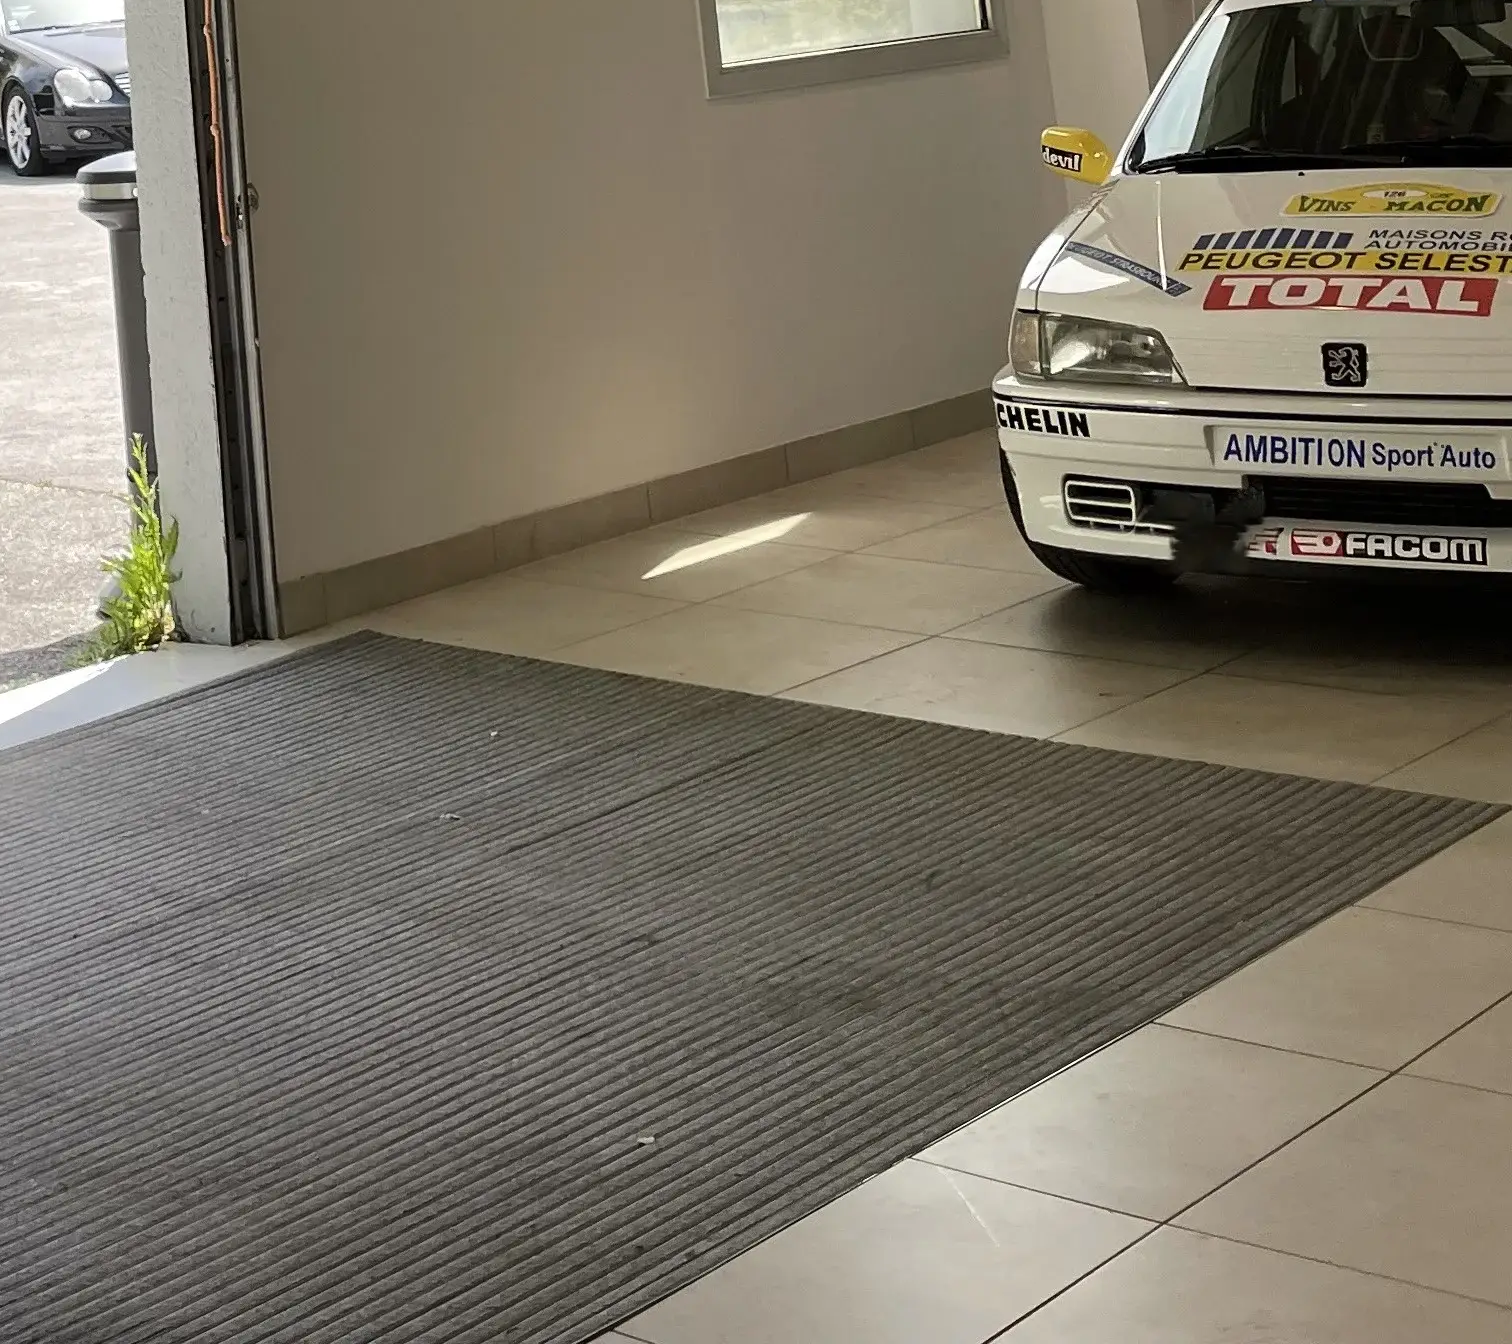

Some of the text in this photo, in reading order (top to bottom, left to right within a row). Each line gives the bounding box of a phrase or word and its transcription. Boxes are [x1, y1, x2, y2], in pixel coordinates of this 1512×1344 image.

[1042, 147, 1080, 171] devil
[1298, 194, 1356, 212] VINS
[1384, 193, 1491, 213] MACON
[1363, 239, 1512, 253] AUTOMOBI
[1368, 229, 1512, 242] MAISONS R
[1178, 251, 1512, 274] PEUGEOT SELEST
[1220, 276, 1480, 312] TOTAL
[1223, 433, 1496, 472] AMBITION Sport Auto
[1345, 533, 1484, 562] FACOM
